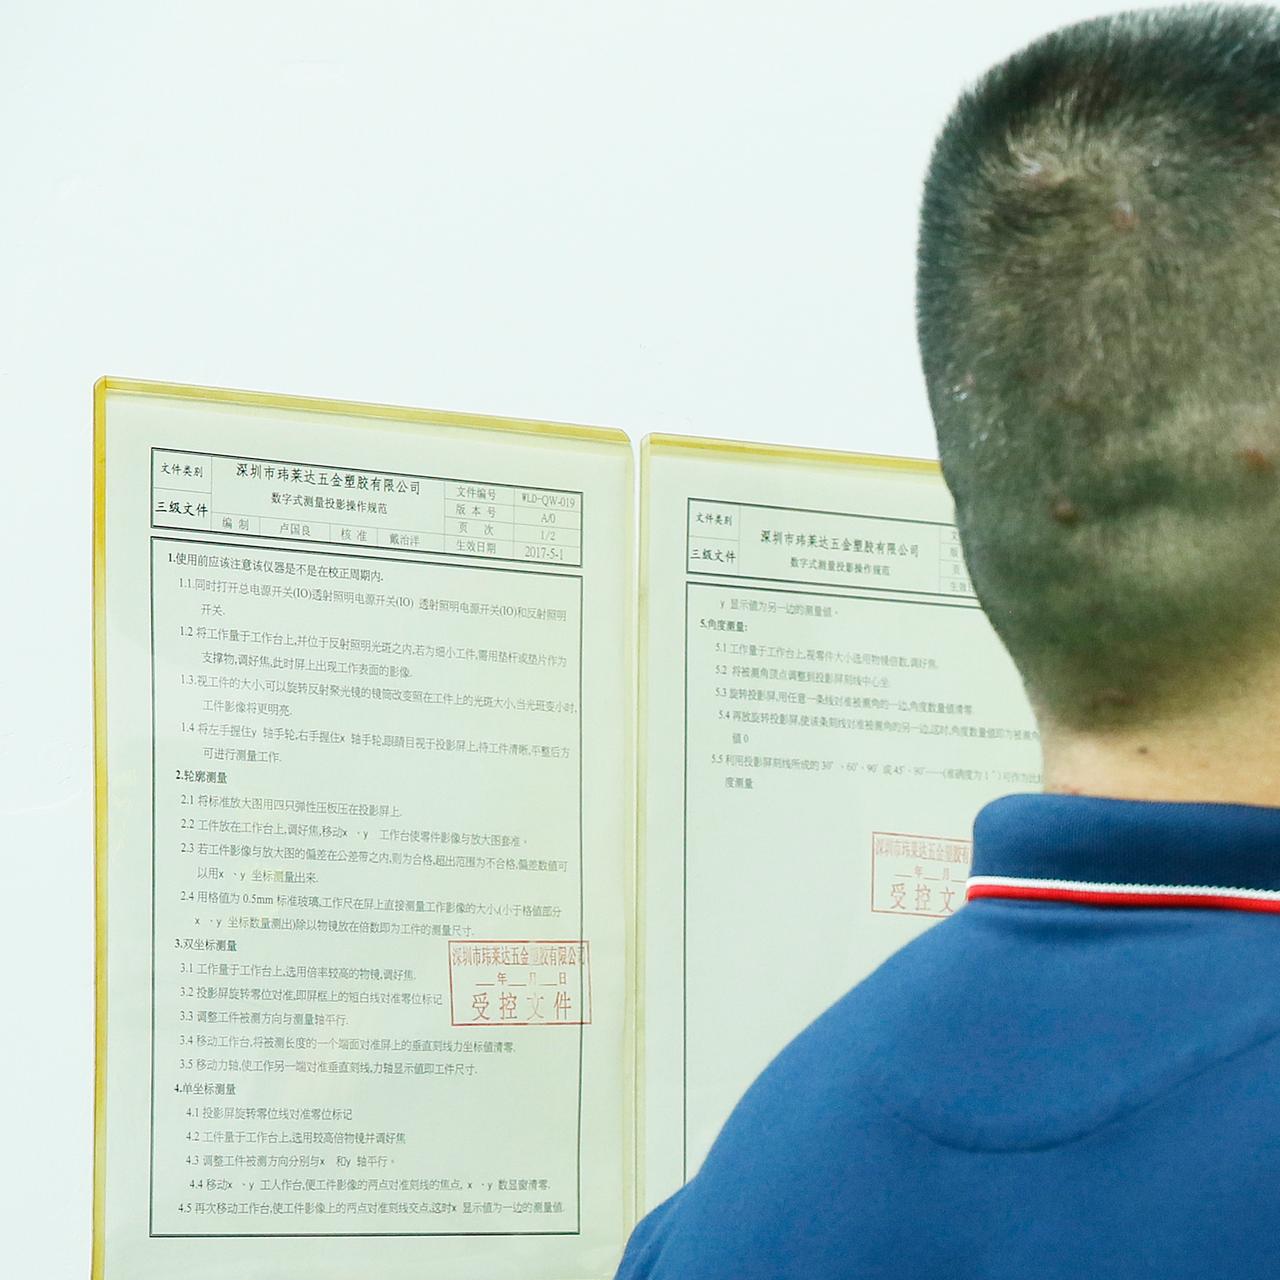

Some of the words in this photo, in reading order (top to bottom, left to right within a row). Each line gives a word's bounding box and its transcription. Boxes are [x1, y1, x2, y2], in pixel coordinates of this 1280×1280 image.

[160, 462, 203, 478] 文件类别
[236, 463, 420, 495] 深圳市玮莱达五金塑胶有限公司
[271, 491, 388, 514] 数字式测量投影操作规范
[456, 486, 497, 501] 文件编号
[521, 492, 576, 508] WLD-QW-019
[155, 501, 208, 518] 三级文件
[540, 529, 556, 541] 1/2
[456, 539, 496, 555] 生效日期
[524, 546, 564, 561] 2017-5-1
[690, 548, 736, 564] 三级文件
[174, 938, 237, 953] 3.双坐标测量
[497, 972, 507, 985] 年
[559, 972, 567, 985] 日
[472, 991, 572, 1021] 受控文件
